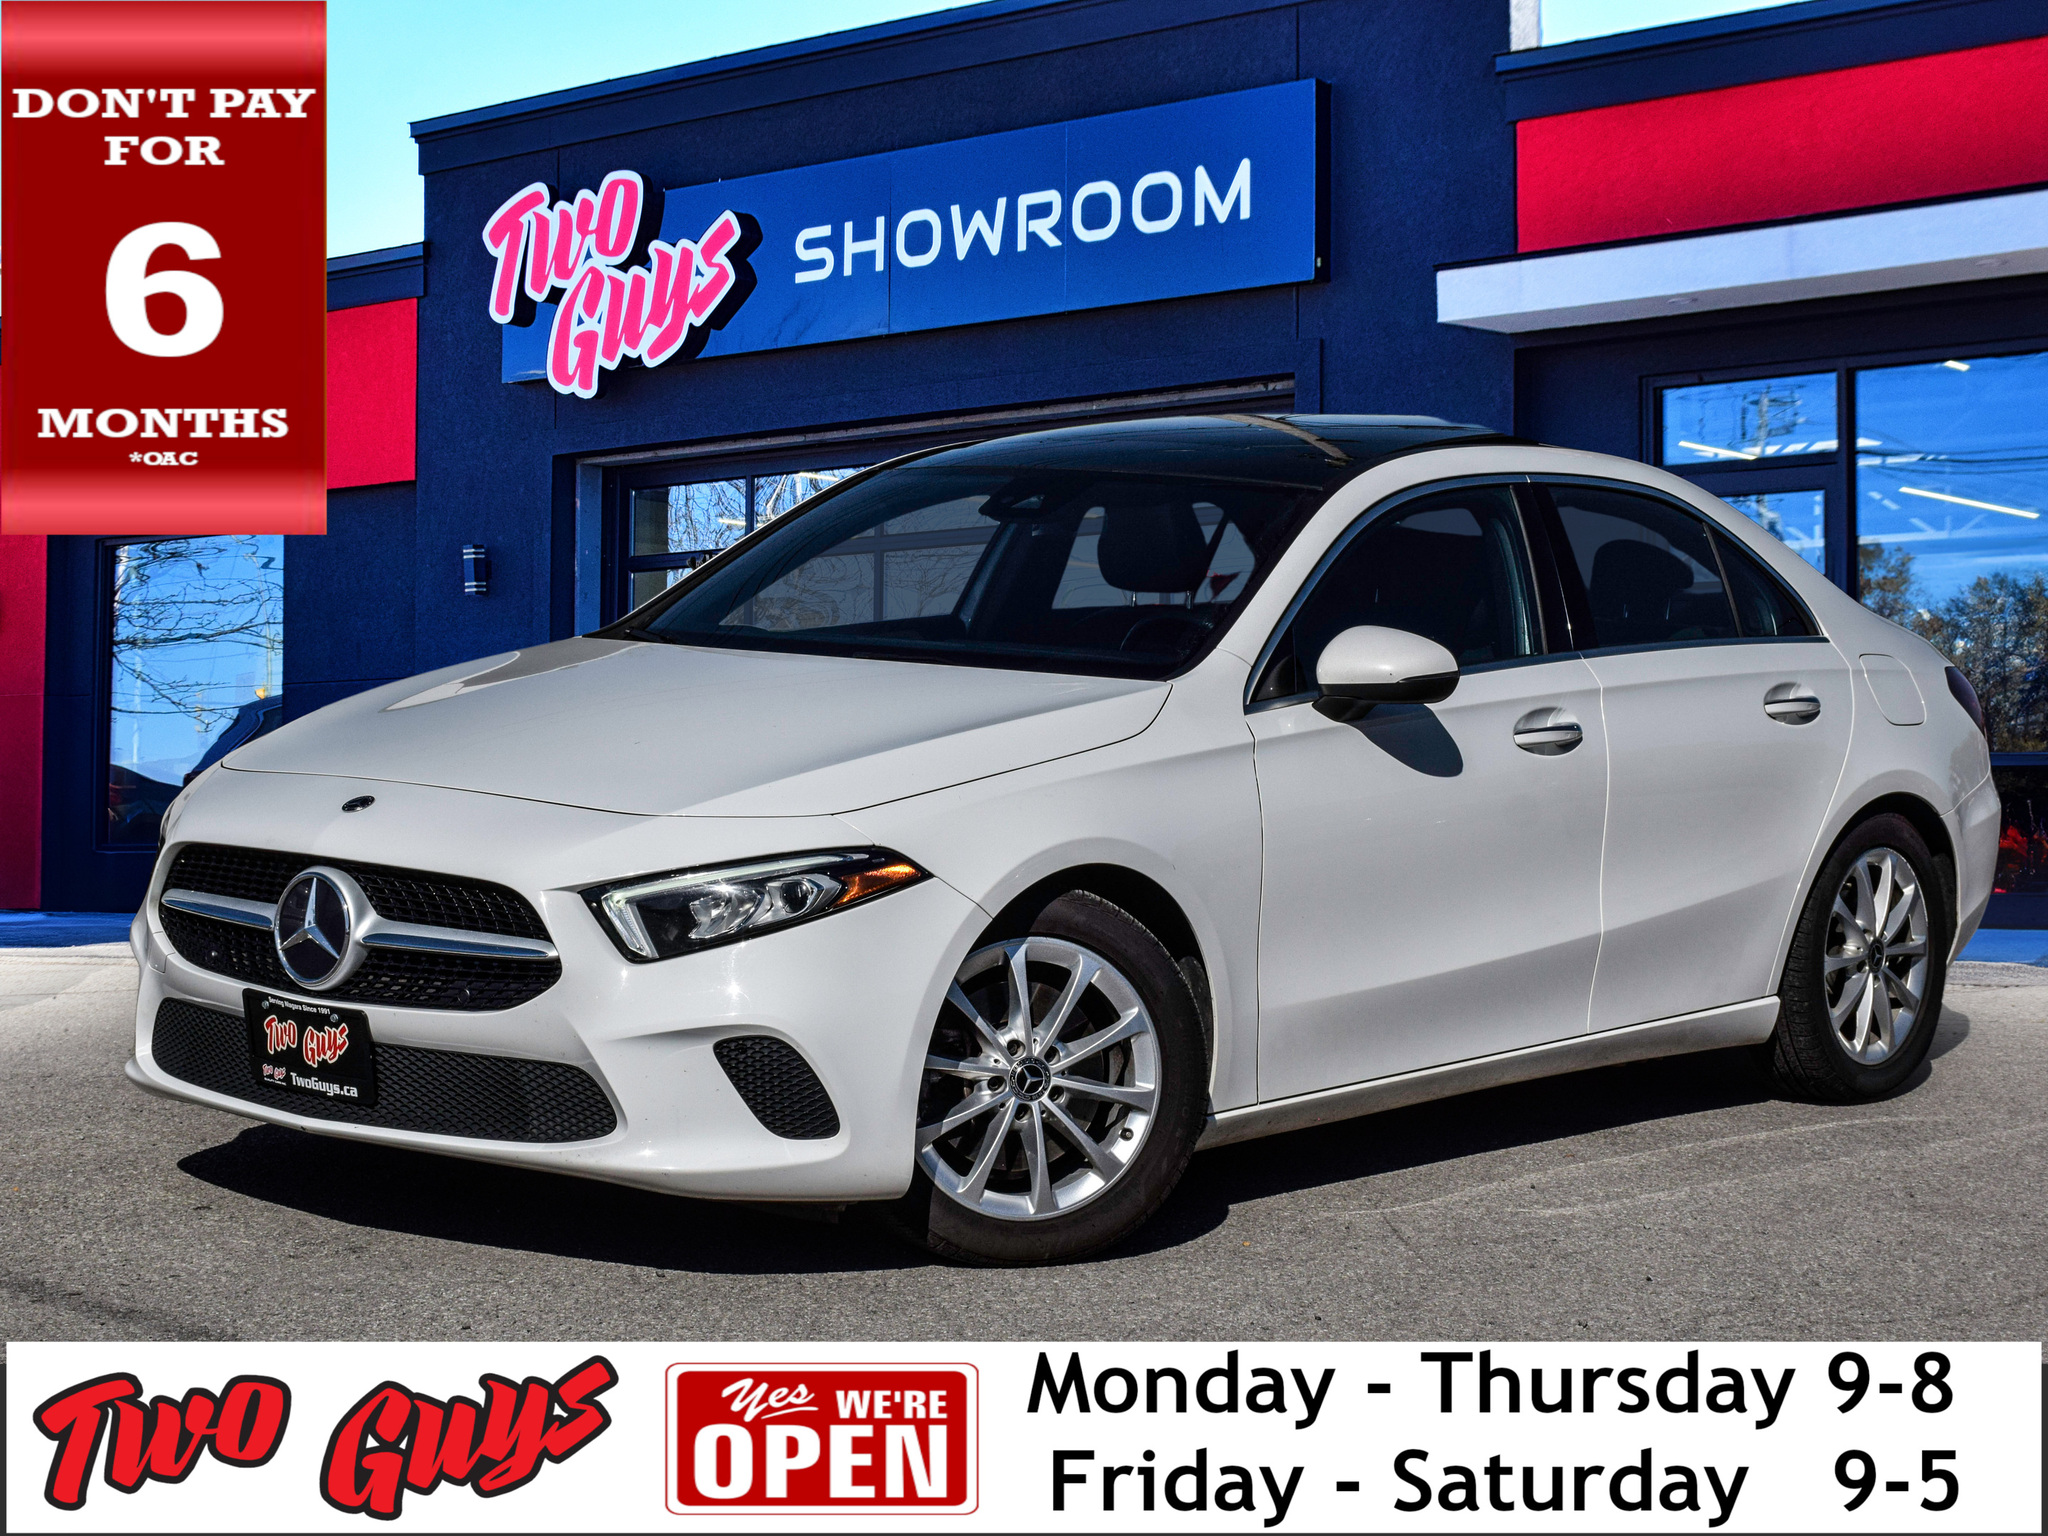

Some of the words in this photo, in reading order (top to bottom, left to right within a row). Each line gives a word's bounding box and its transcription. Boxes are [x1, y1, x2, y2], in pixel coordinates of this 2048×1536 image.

[482, 170, 643, 324] Two
[795, 157, 1251, 283] SHOWROOM
[547, 209, 741, 399] Guys
[264, 1015, 298, 1054] Two
[303, 1023, 349, 1068] Guys
[290, 1072, 358, 1097] TwoGuys.ca
